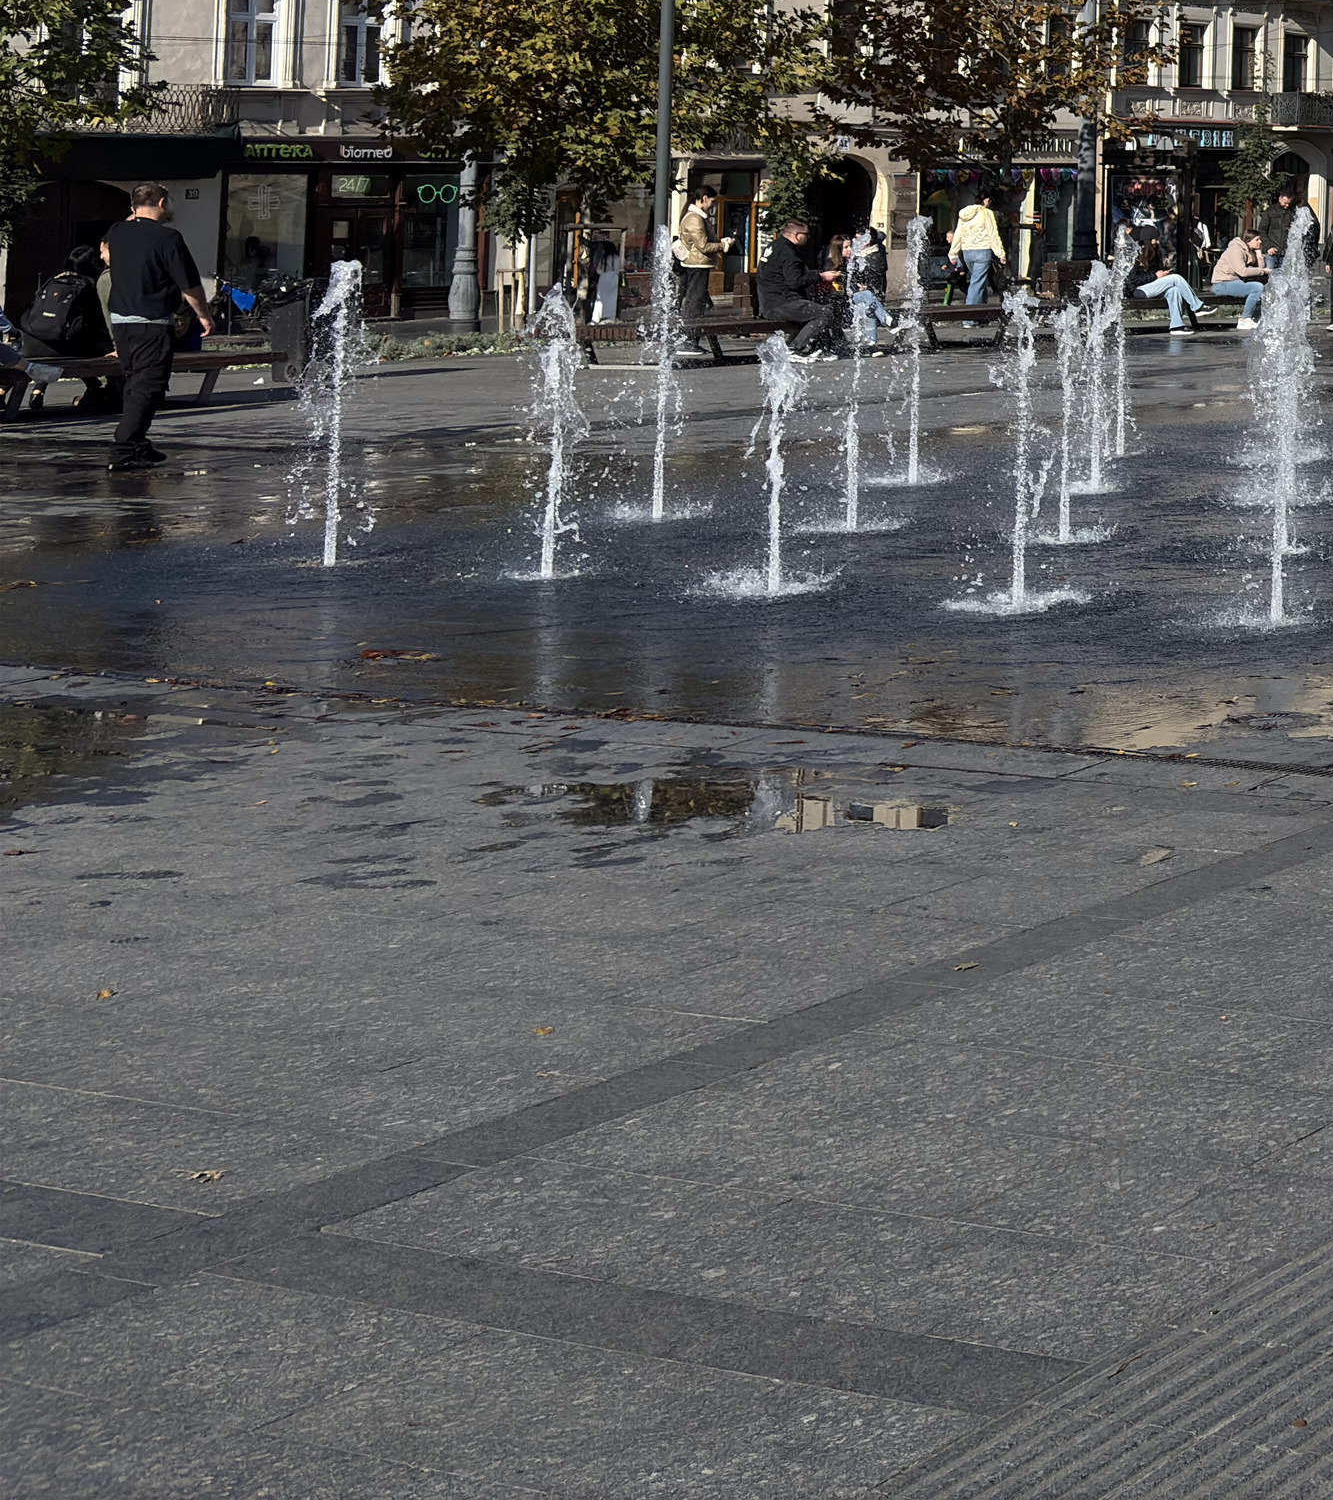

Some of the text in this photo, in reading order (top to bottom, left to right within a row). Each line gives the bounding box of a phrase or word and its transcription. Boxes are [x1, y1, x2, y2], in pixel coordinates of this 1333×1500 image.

[244, 143, 314, 159] АПТЕКА
[340, 145, 393, 159] biomed
[338, 177, 371, 193] 24/7
[187, 189, 199, 199] 39
